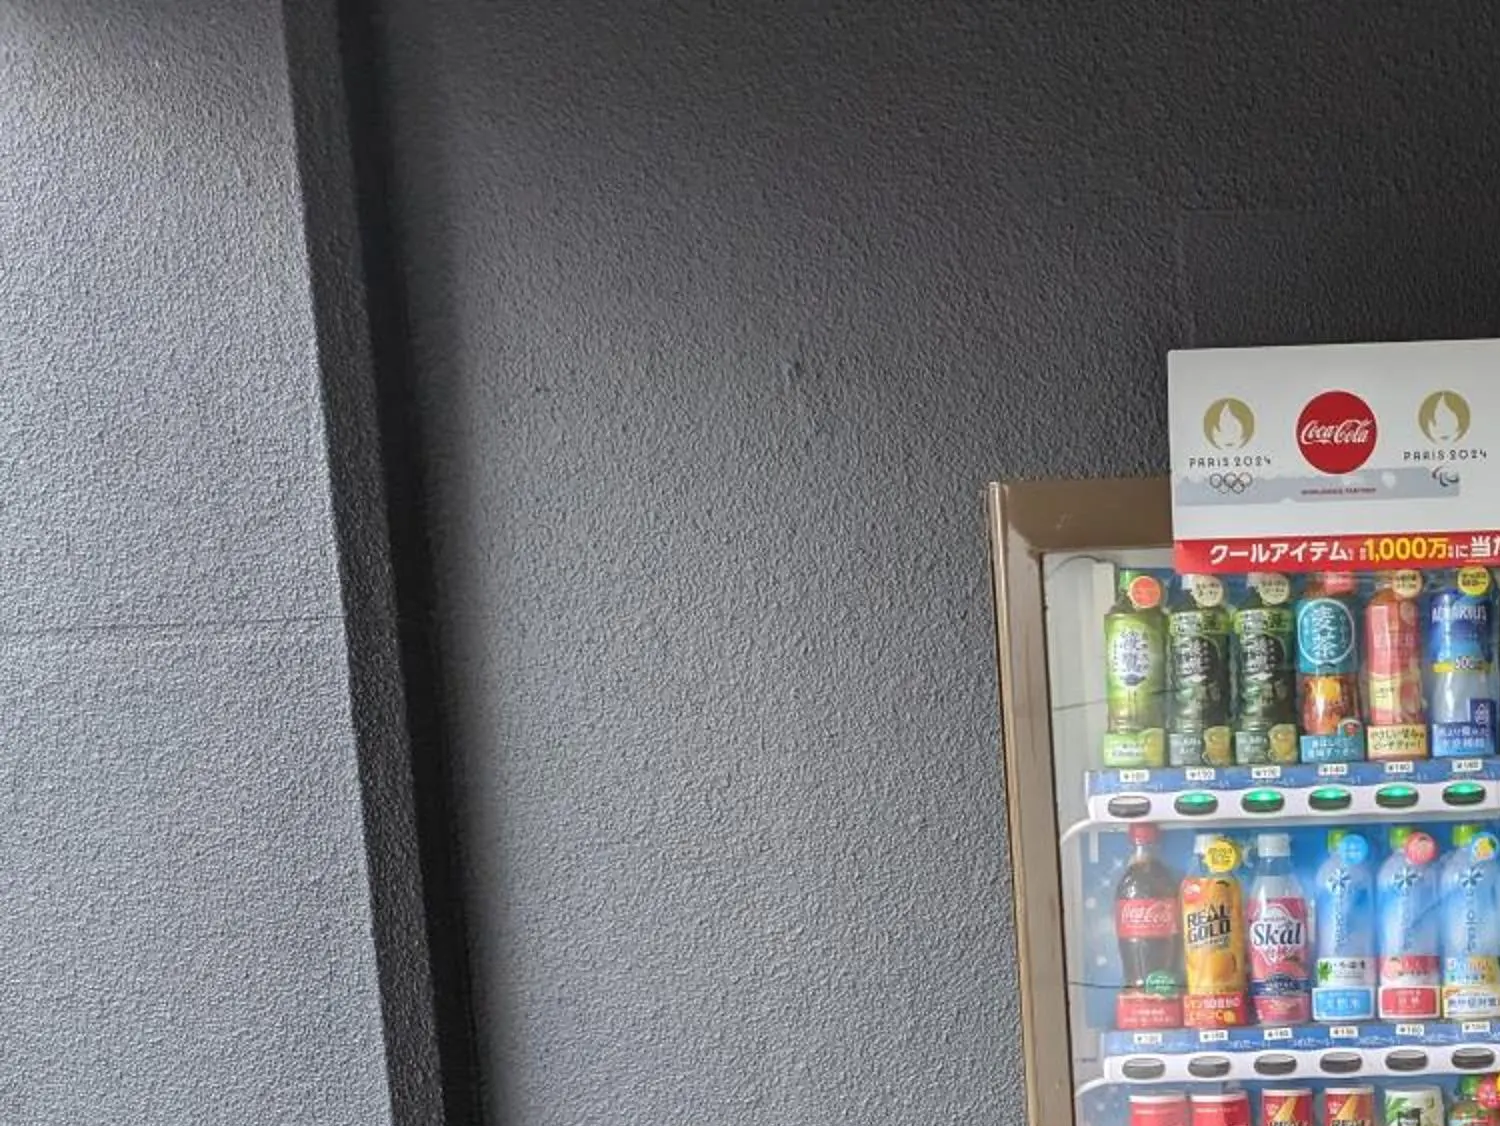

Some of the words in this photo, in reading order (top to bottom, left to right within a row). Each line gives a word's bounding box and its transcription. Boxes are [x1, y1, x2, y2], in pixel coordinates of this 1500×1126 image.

[1301, 419, 1375, 445] Coca-Cola
[1189, 456, 1229, 468] PARIS
[1233, 456, 1271, 467] 2024
[1404, 449, 1444, 461] PARIS
[1449, 448, 1488, 460] 2024
[1187, 904, 1231, 928] REAL
[1188, 919, 1231, 945] GOLD
